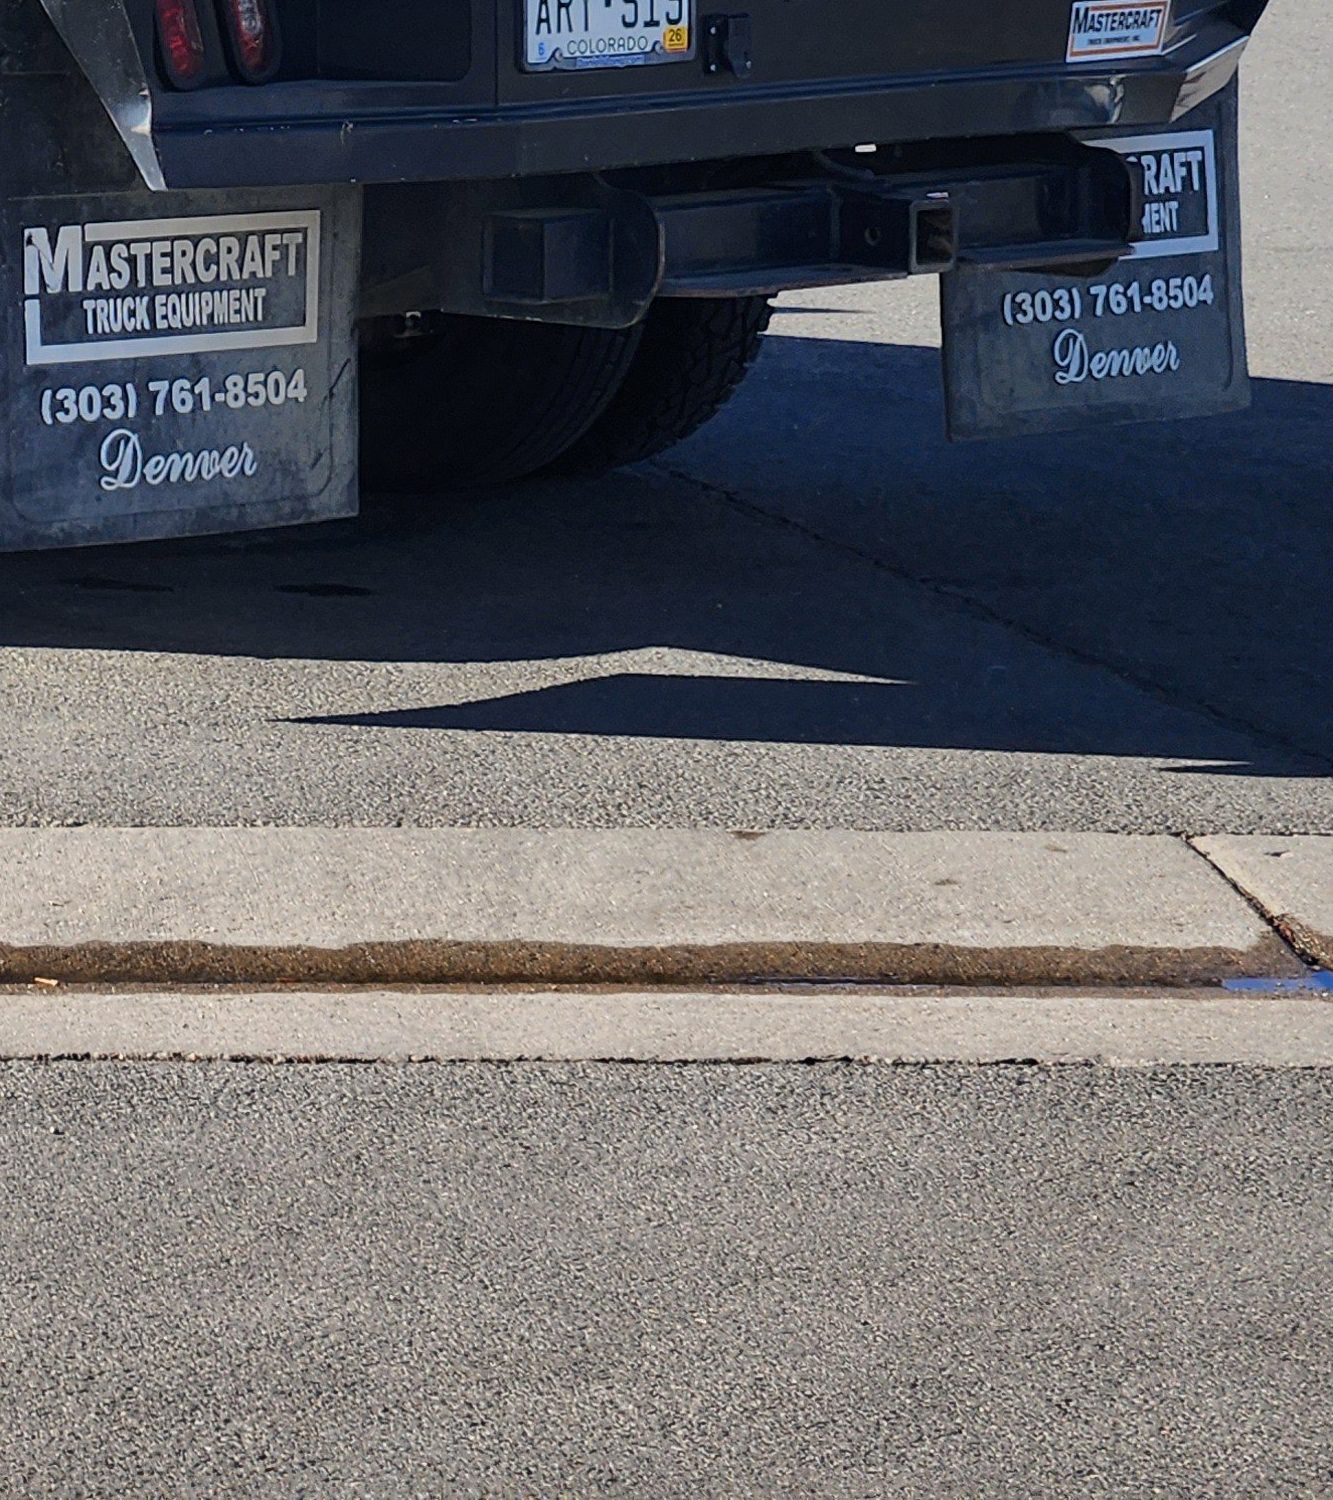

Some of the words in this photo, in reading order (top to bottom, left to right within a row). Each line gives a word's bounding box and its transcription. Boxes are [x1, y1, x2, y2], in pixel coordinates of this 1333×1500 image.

[566, 35, 649, 56] COLORADO
[668, 28, 683, 42] 26
[1073, 6, 1163, 34] MASTERCRAFT
[23, 224, 304, 296] MASTERCRAFT
[83, 295, 151, 335] TRUCK
[154, 288, 267, 330] EQUIPMENT
[1002, 289, 1082, 327] (303)
[1089, 273, 1214, 318] 761-8504
[1053, 327, 1181, 385] Denver
[40, 382, 137, 426] (303)
[148, 368, 308, 416] 761-8504
[99, 427, 258, 491] Denver
